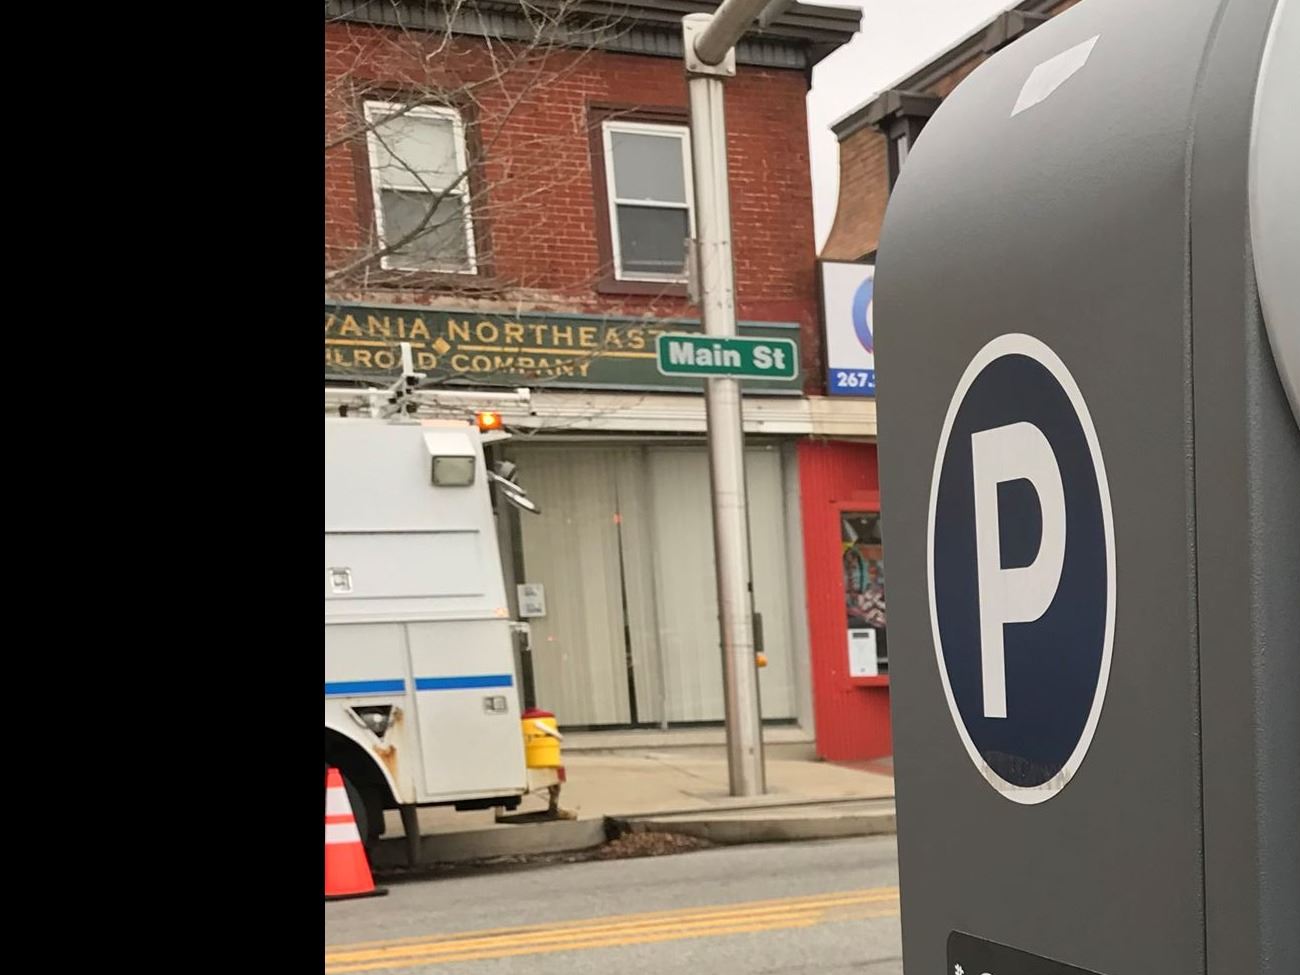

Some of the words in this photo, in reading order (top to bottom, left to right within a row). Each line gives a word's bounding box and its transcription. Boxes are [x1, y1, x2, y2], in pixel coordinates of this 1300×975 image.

[448, 320, 661, 349] NORTHEAS
[669, 341, 741, 367] Main
[753, 345, 786, 370] St
[971, 421, 1066, 718] P
